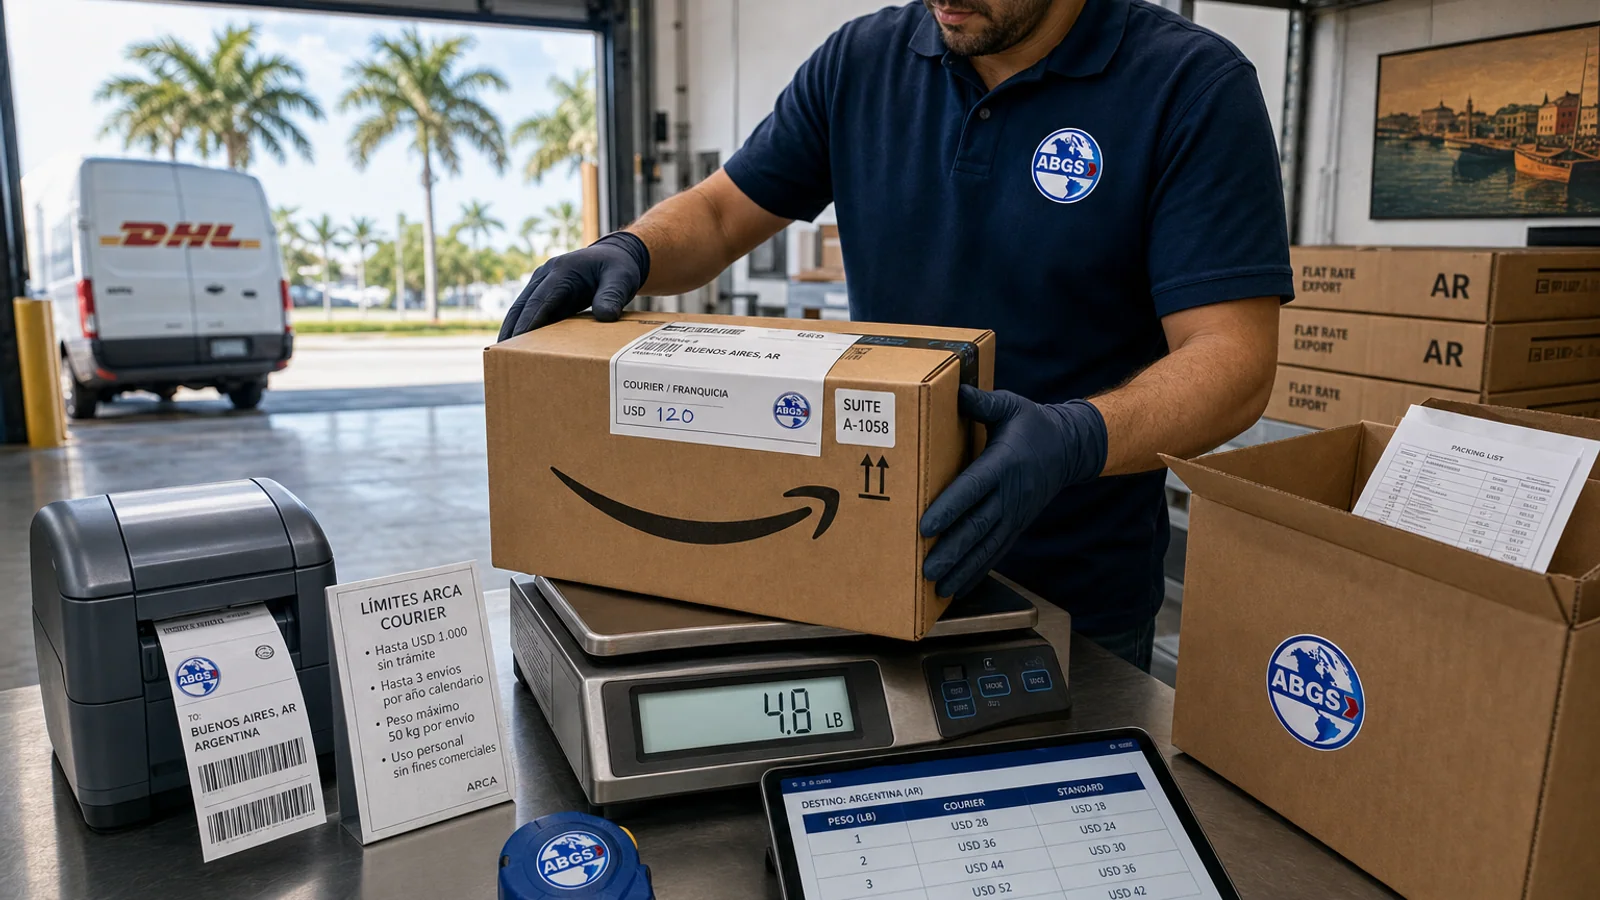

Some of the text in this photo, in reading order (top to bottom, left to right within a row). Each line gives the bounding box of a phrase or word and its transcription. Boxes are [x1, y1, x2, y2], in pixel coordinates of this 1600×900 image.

[1036, 154, 1085, 174] ABGS
[121, 222, 240, 248] DHL
[1302, 266, 1356, 279] FLAT RATE
[1302, 281, 1342, 293] EXPORT
[1430, 273, 1470, 299] AR
[1294, 324, 1348, 340] FLAT RATE
[684, 346, 727, 356] BUENOS
[728, 349, 761, 359] AIRES,
[765, 352, 781, 360] AR
[1294, 339, 1334, 354] EXPORT
[1422, 340, 1464, 367] AR
[623, 380, 664, 392] COURIER
[672, 384, 729, 398] FRANQUICIA
[1289, 382, 1340, 400] FLAT RATE
[623, 405, 646, 417] USD
[776, 406, 802, 416] ABGS
[843, 398, 881, 413] SUITE
[1288, 397, 1328, 412] EXPORT
[656, 407, 695, 423] 120
[843, 418, 889, 434] A-1058
[1451, 444, 1504, 462] PACKING LIST
[361, 584, 463, 615] LÍMITES ARCA
[380, 606, 447, 630] COURIER
[375, 626, 468, 656] Hasta USD 1.000
[378, 658, 394, 671] sin
[179, 671, 211, 686] ABGS
[380, 676, 414, 691] Hasta
[416, 672, 424, 683] 3
[383, 674, 484, 709] por año calendario
[1271, 669, 1341, 711] ABGS
[188, 713, 202, 722] TO:
[191, 702, 297, 737] BUENOS AIRES, AR
[386, 702, 460, 728] Peso máximo
[764, 688, 844, 736] 4.8 LB
[194, 727, 261, 752] ARGENTINA
[388, 729, 403, 743] 50
[406, 727, 421, 740] kg
[423, 721, 442, 736] por
[391, 734, 464, 763] Uso personal
[393, 743, 497, 779] sin fines comerciales
[466, 776, 498, 792] ARCA
[1057, 782, 1104, 797] STANDARD
[801, 786, 924, 809] DESTINO: ARGENTINA (AR)
[943, 798, 985, 811] COURIER
[1071, 801, 1107, 814] USD 18
[828, 811, 877, 826] PESO (LB)
[951, 817, 989, 831] USD 28
[1079, 821, 1117, 835] USD 24
[854, 834, 862, 844] 1
[958, 838, 996, 852] USD 36
[1088, 842, 1127, 856] USD 30
[543, 848, 594, 875] ABGS
[860, 856, 867, 866] 2
[965, 860, 1005, 875] USD 44
[1098, 863, 1137, 878] USD 36
[865, 879, 873, 889] 3
[972, 882, 1013, 898] USD 52
[1108, 885, 1147, 900] USD 42
